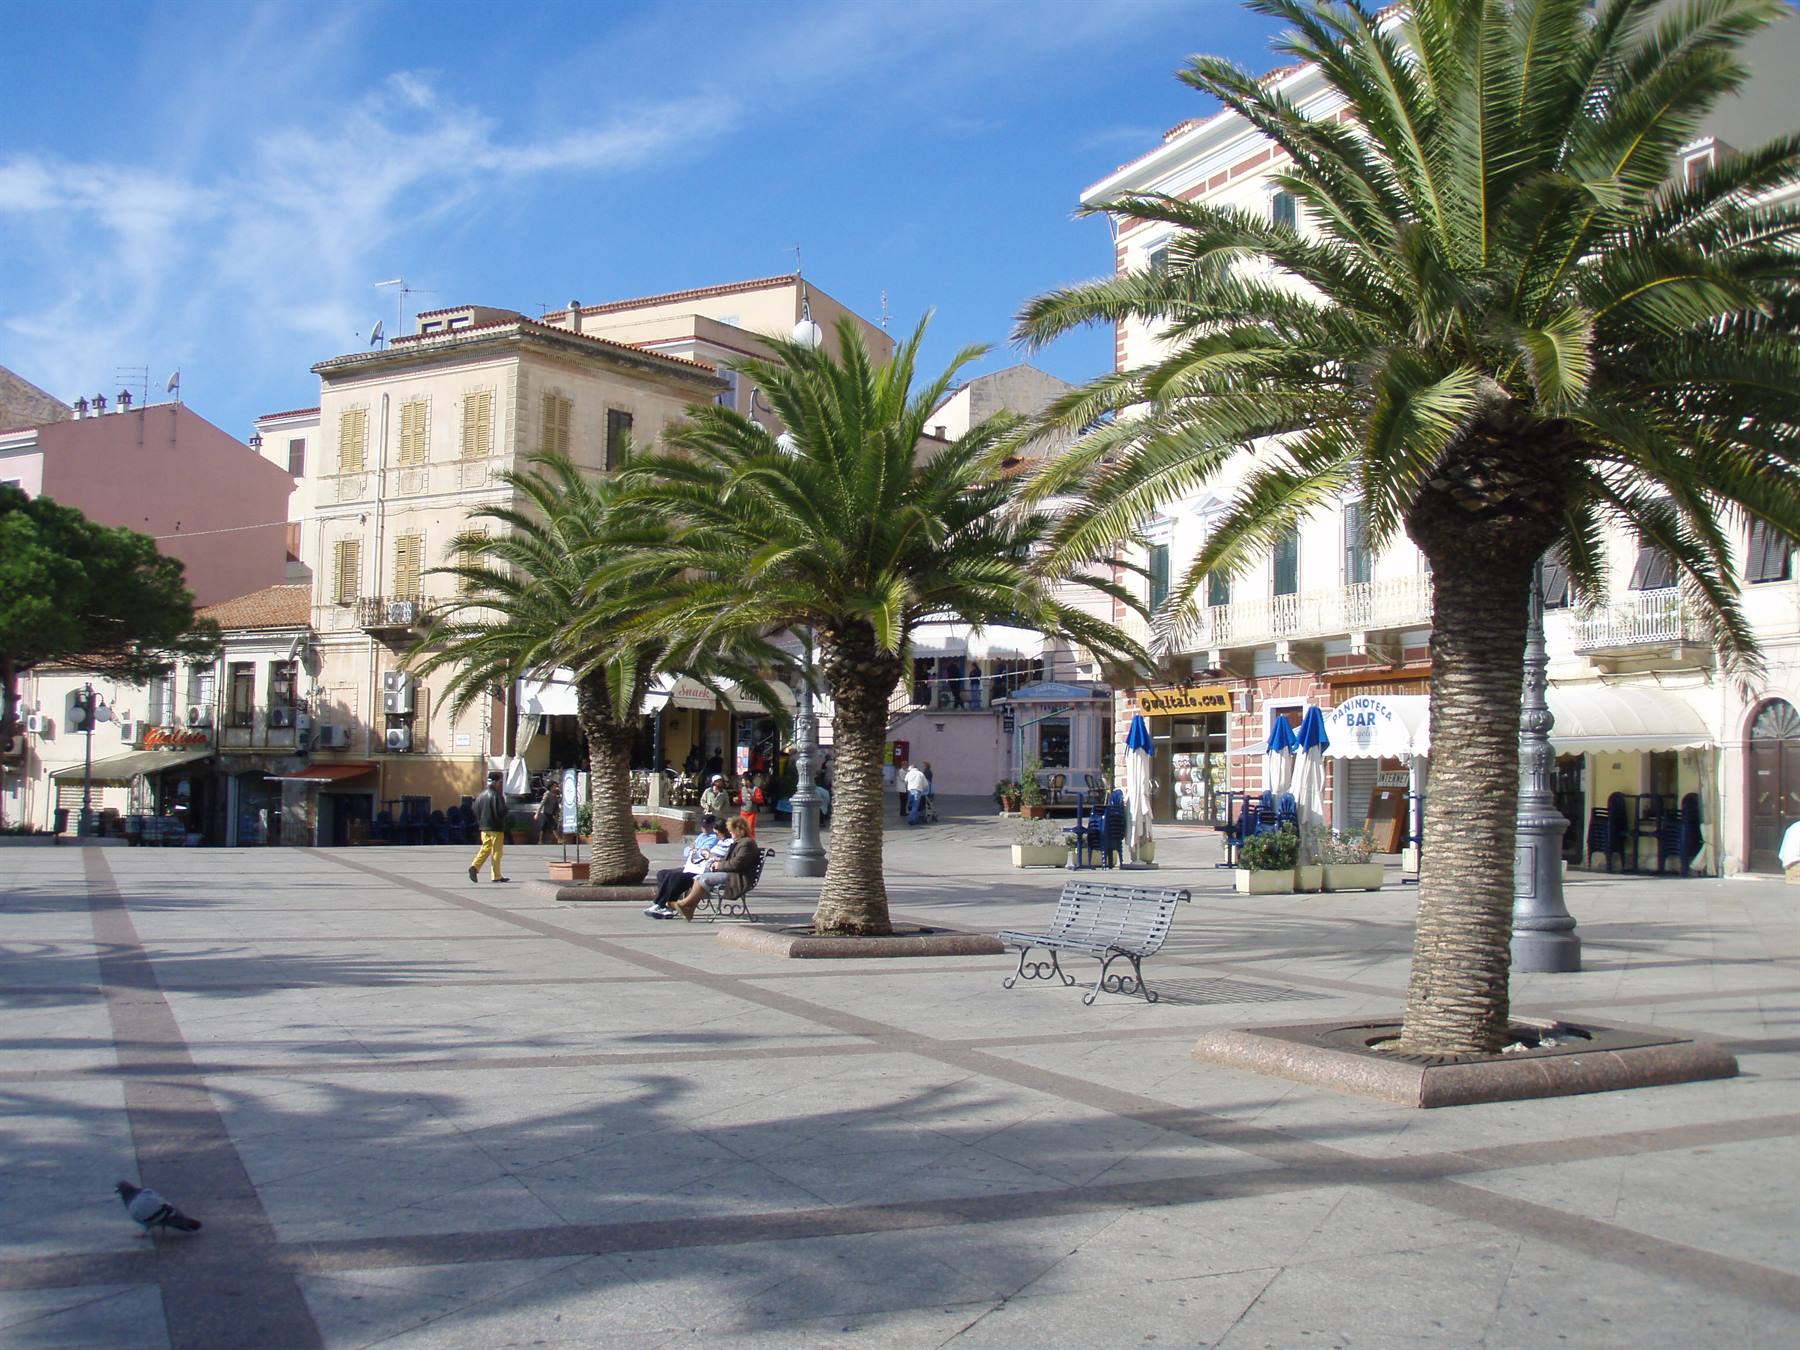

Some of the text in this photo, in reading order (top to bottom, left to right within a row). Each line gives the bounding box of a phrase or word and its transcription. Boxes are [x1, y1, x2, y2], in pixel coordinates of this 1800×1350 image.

[679, 683, 710, 698] Snack
[1332, 698, 1392, 724] PANINOTECA
[1346, 712, 1376, 727] BAR
